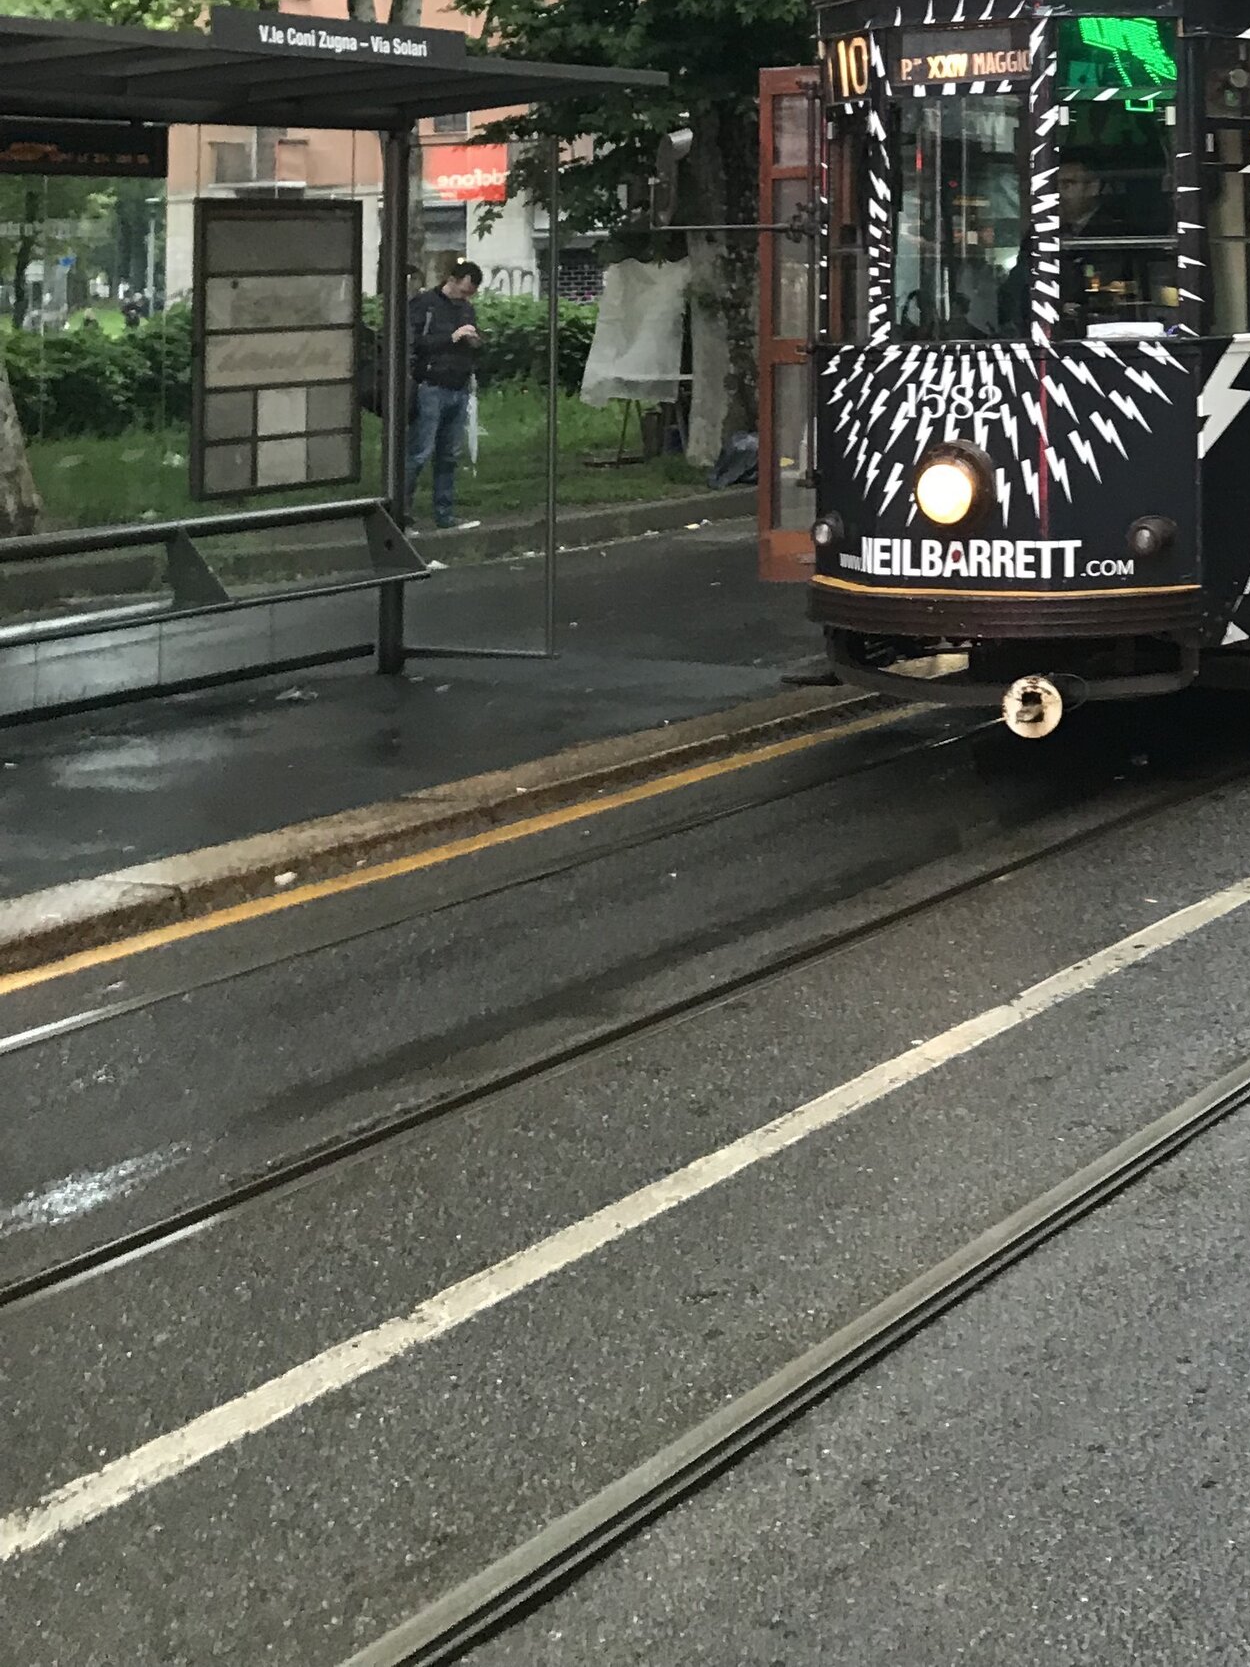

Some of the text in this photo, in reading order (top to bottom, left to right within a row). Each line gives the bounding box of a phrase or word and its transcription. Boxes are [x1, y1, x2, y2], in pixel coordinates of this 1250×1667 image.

[258, 25, 285, 44] V.le
[287, 27, 316, 47] Coni
[318, 30, 358, 53] Zugna
[370, 35, 391, 54] Via
[392, 37, 428, 57] Solari
[837, 36, 868, 97] 10
[906, 383, 1003, 419] 1582
